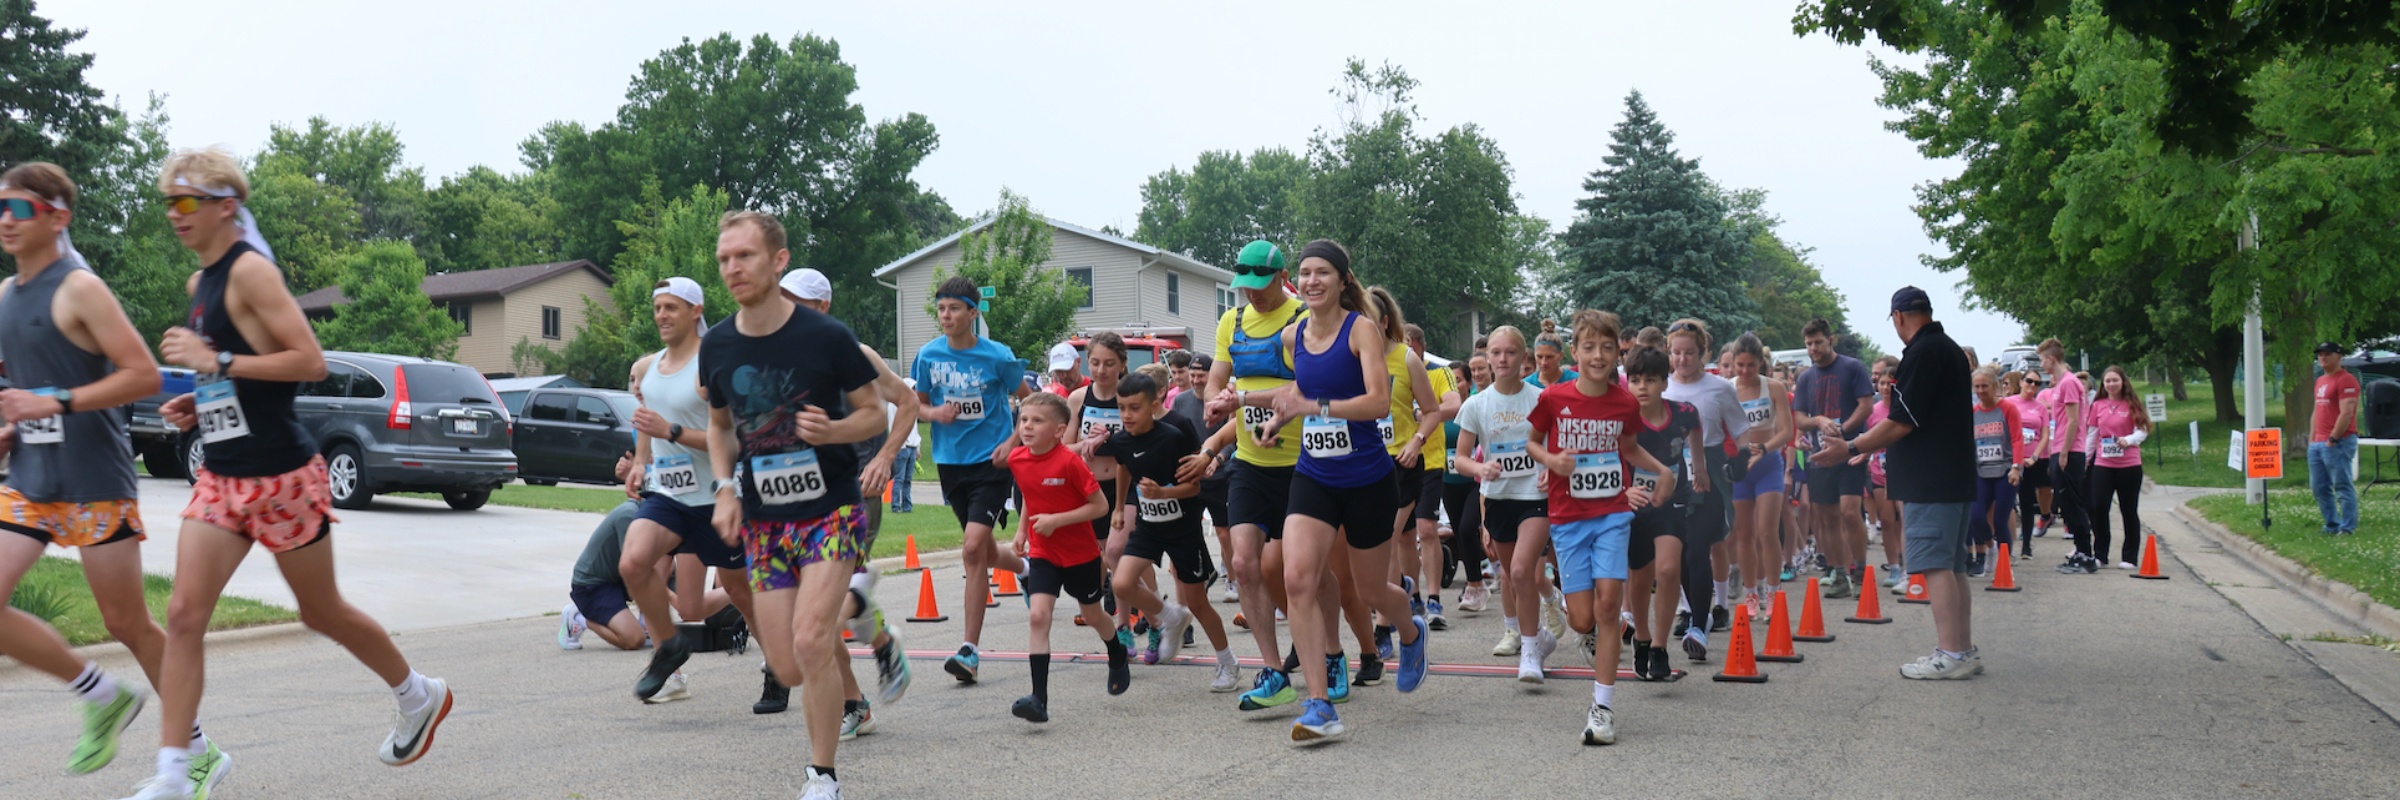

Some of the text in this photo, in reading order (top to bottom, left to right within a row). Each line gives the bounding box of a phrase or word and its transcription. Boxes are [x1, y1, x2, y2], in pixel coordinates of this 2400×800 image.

[1245, 407, 1274, 424] 395
[1748, 409, 1770, 423] 034
[1556, 416, 1624, 437] WISCONSIN
[1305, 431, 1348, 450] 3958
[1557, 432, 1619, 451] BADGERS
[1978, 448, 2001, 458] 3974
[660, 470, 695, 489] 4002
[761, 471, 821, 498] 4086
[1571, 471, 1621, 491] 3928
[1141, 500, 1178, 516] 3960
